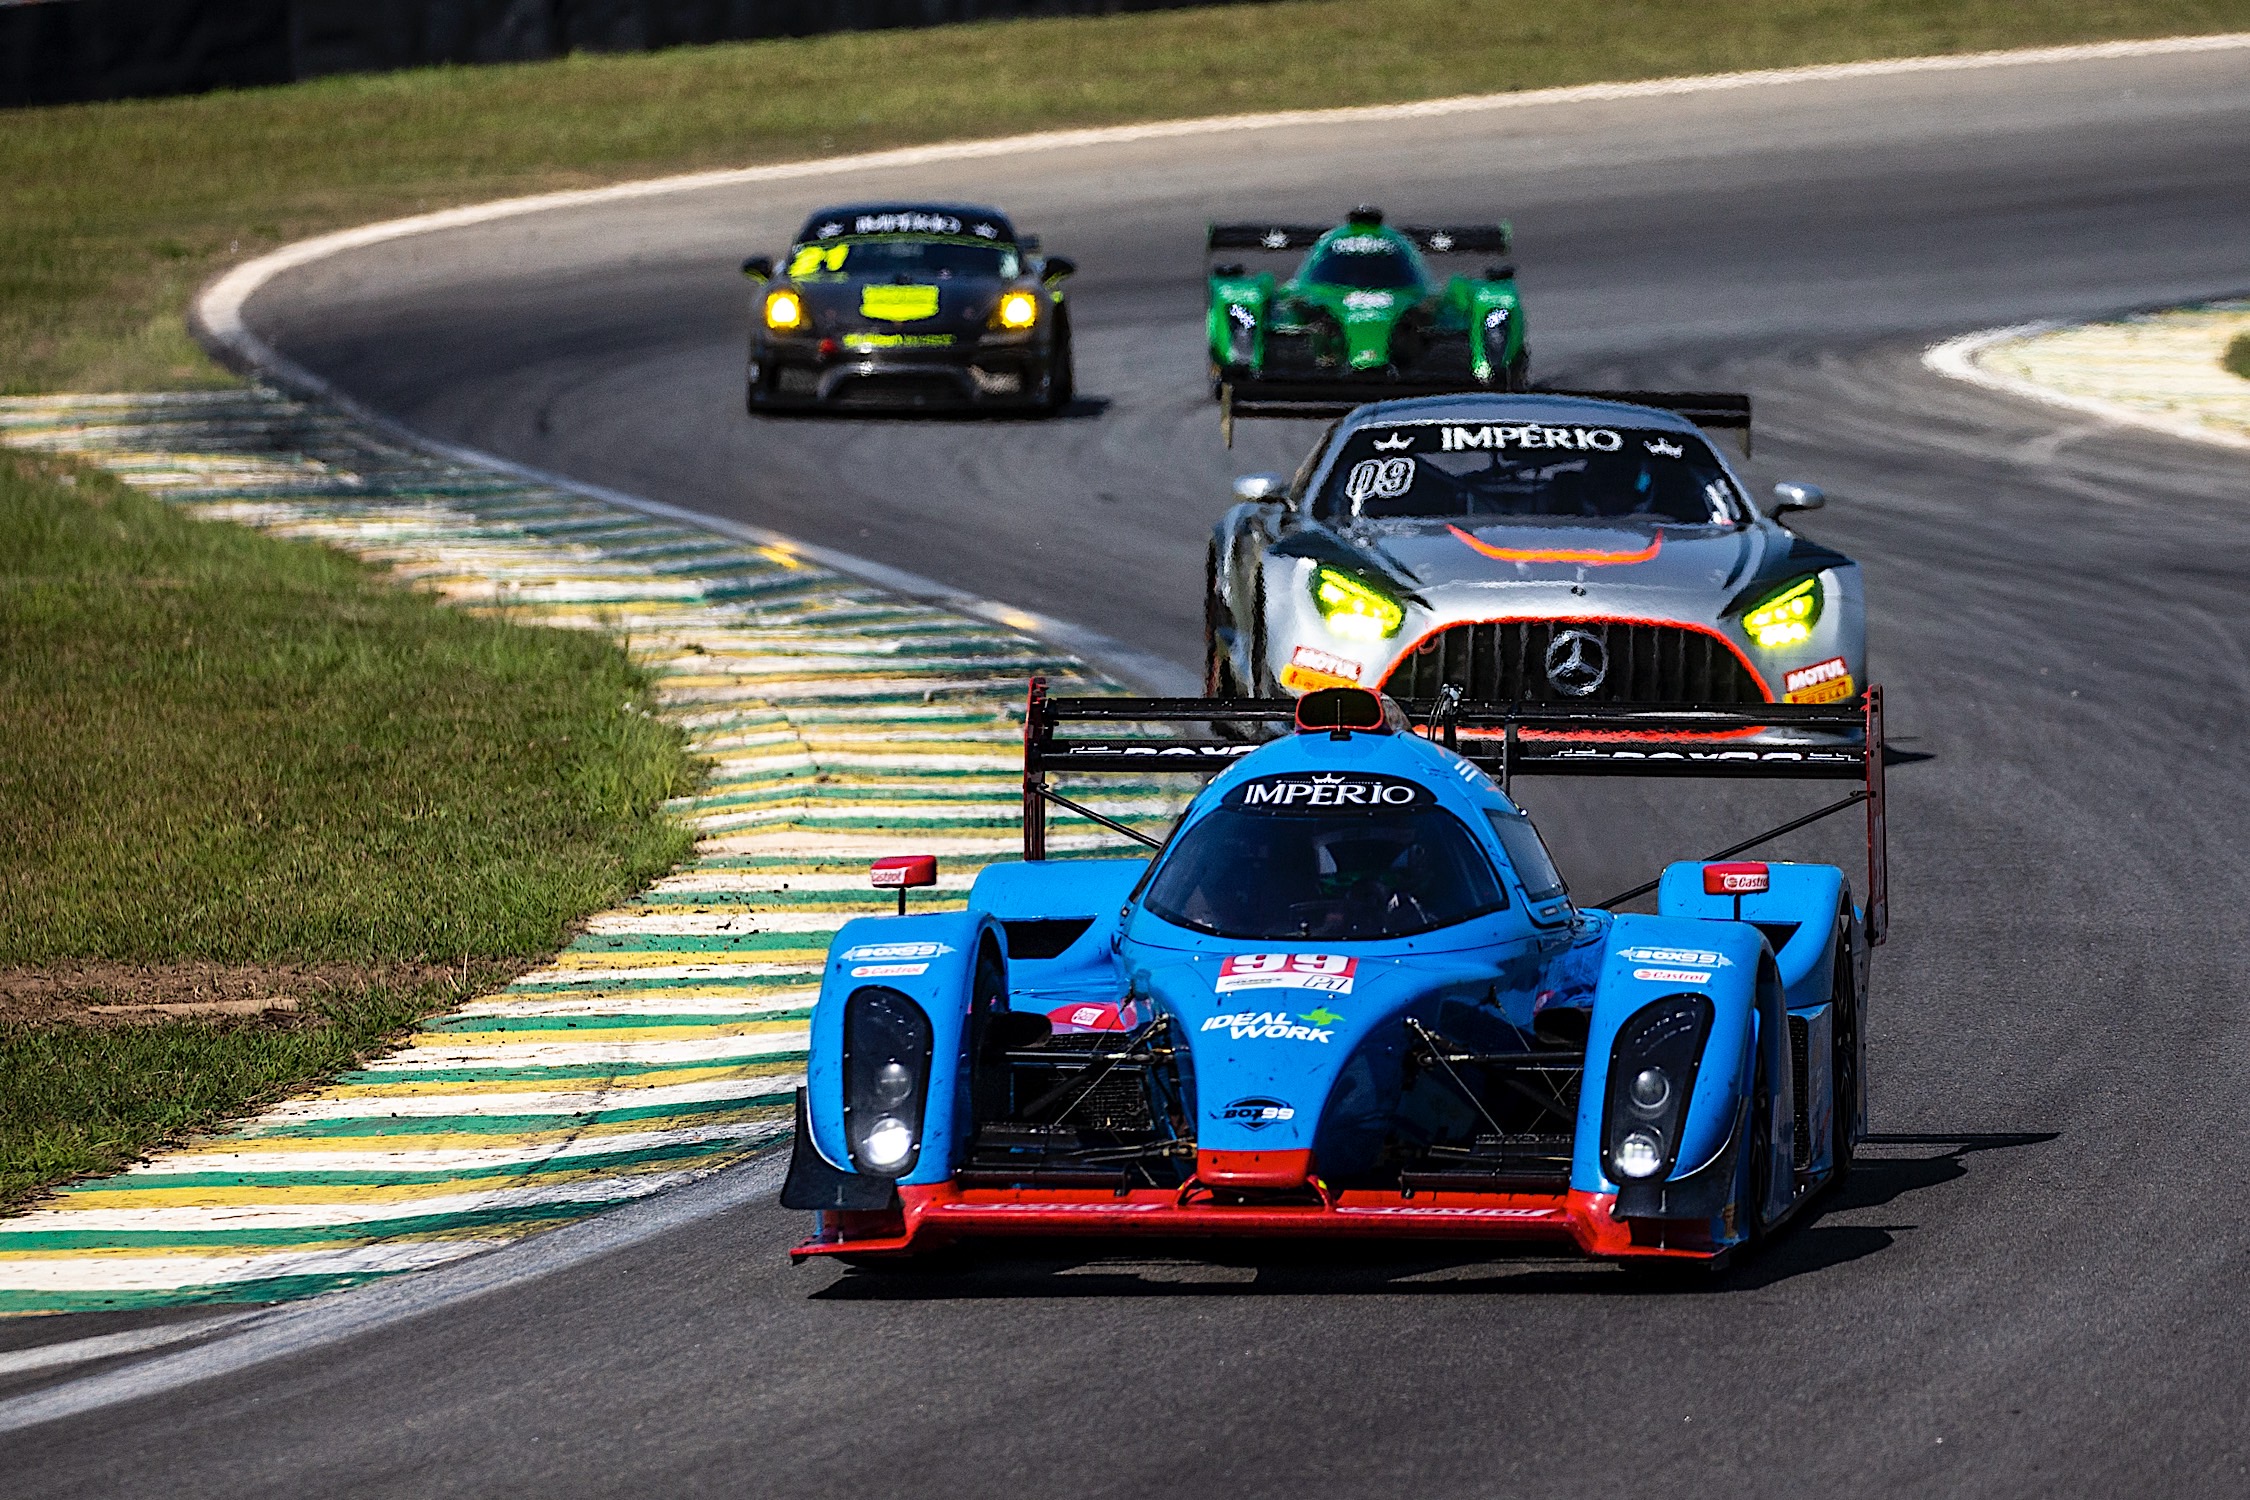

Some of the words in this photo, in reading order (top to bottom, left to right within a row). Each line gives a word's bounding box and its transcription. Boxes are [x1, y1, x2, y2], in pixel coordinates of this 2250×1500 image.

[1787, 658, 1846, 692] MOTUL
[1738, 876, 1768, 888] Castro
[1231, 953, 1349, 974] 99
[1635, 950, 1719, 965] BOX99
[1303, 975, 1349, 990] P1
[1653, 971, 1706, 982] Castrol
[1200, 1011, 1293, 1031] IDEAL
[1229, 1024, 1335, 1043] WORK
[1224, 1107, 1295, 1120] BOX99
